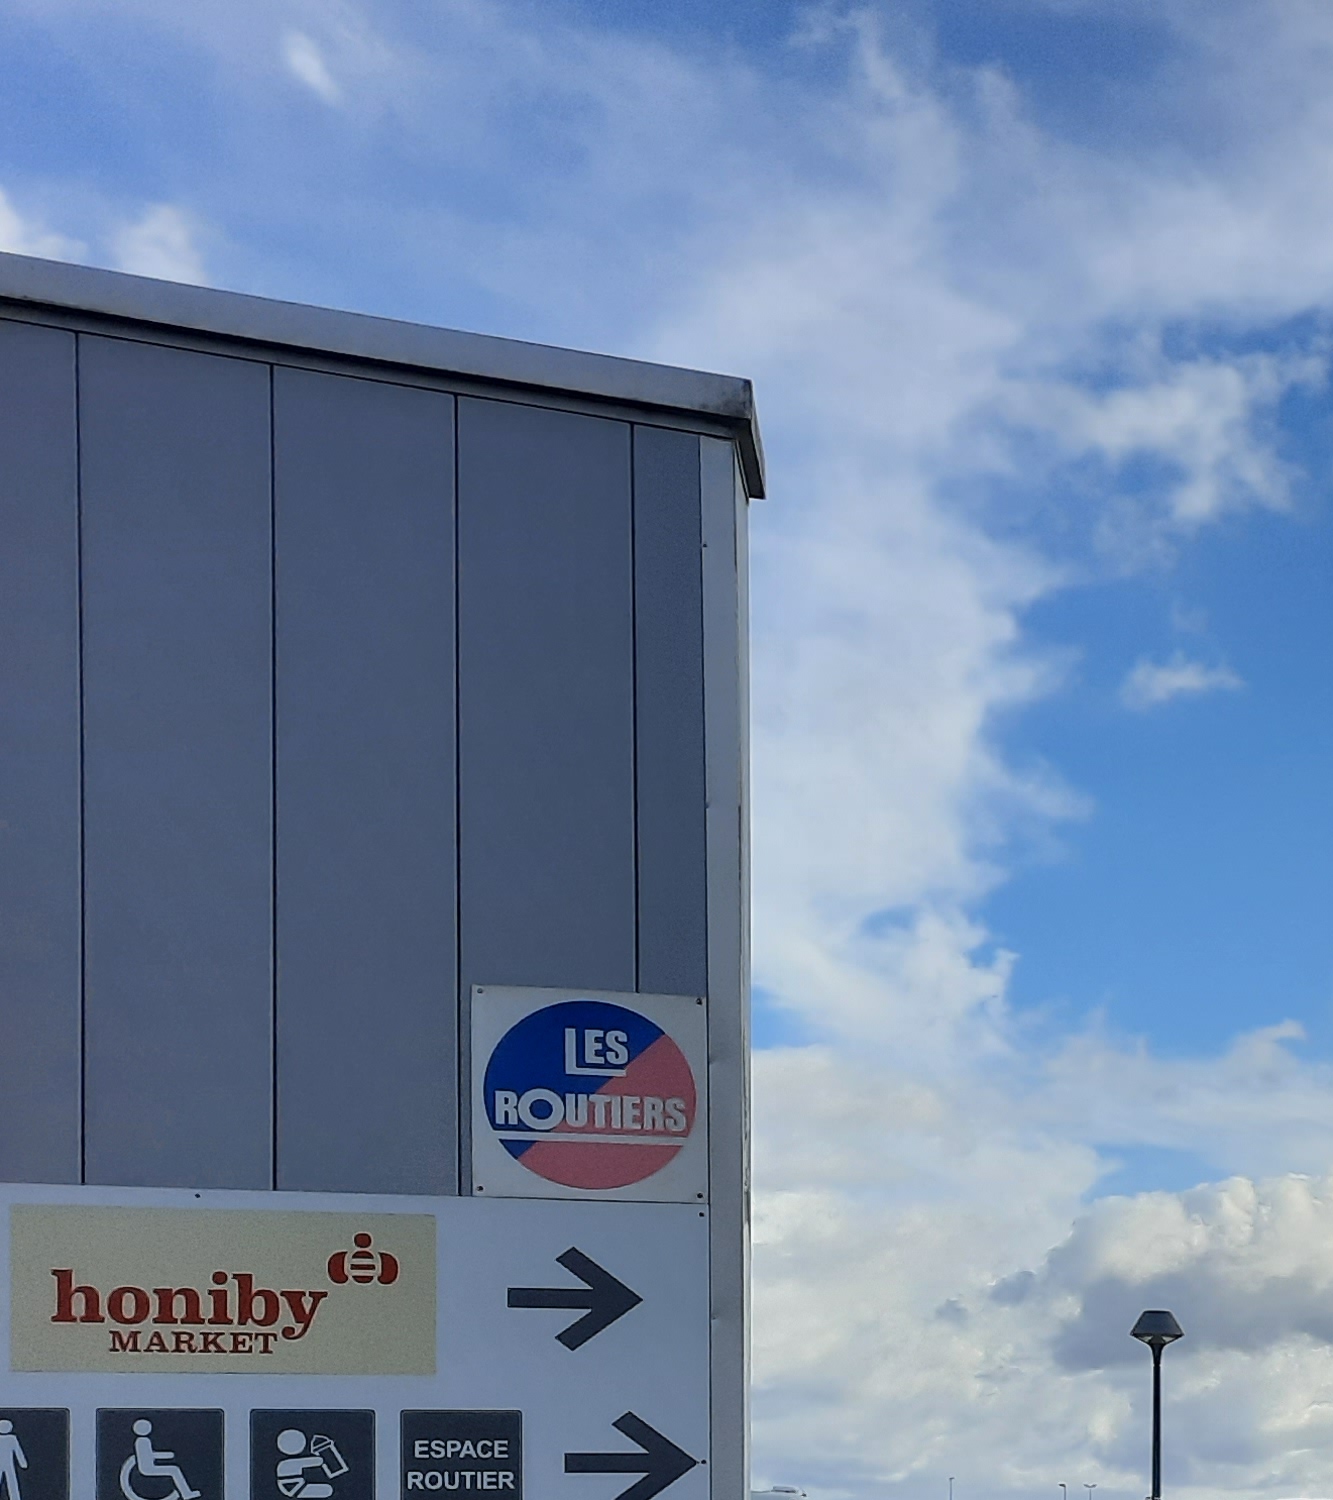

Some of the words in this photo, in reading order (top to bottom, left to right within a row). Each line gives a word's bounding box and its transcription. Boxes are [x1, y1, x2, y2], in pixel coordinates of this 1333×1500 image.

[564, 1027, 628, 1076] LES
[494, 1088, 687, 1132] ROUTIERS
[50, 1268, 328, 1340] honiby
[109, 1330, 278, 1354] MARKET
[414, 1440, 509, 1458] ESPACE
[407, 1471, 515, 1490] ROUTIER
